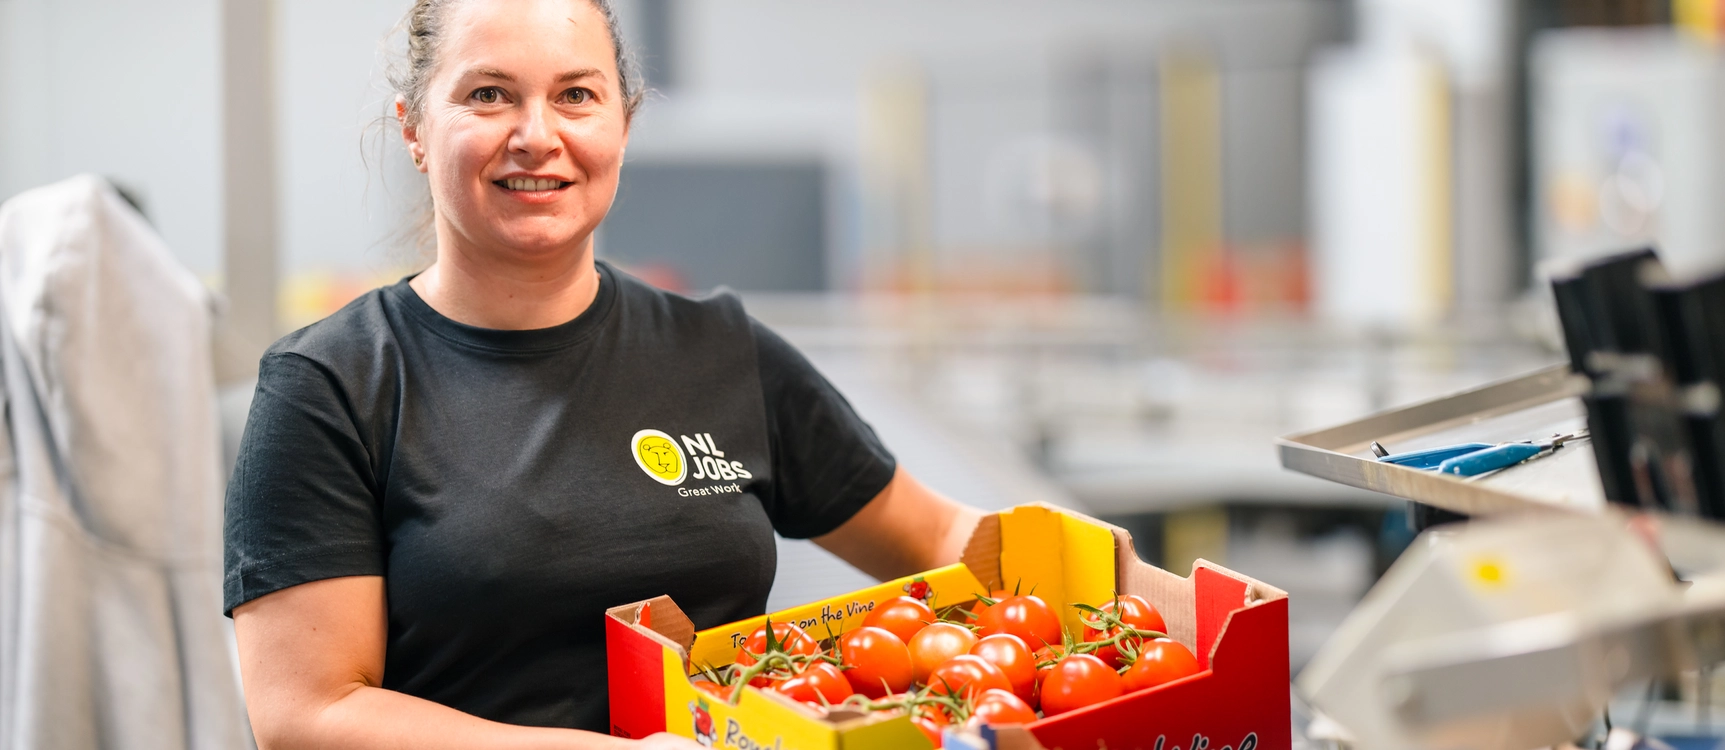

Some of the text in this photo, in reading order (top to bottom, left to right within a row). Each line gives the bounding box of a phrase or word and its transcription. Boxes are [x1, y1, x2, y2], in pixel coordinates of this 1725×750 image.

[681, 433, 724, 457] NL
[693, 456, 752, 480] JOBS
[678, 483, 742, 497] Great Work
[799, 601, 875, 629] on the Vine
